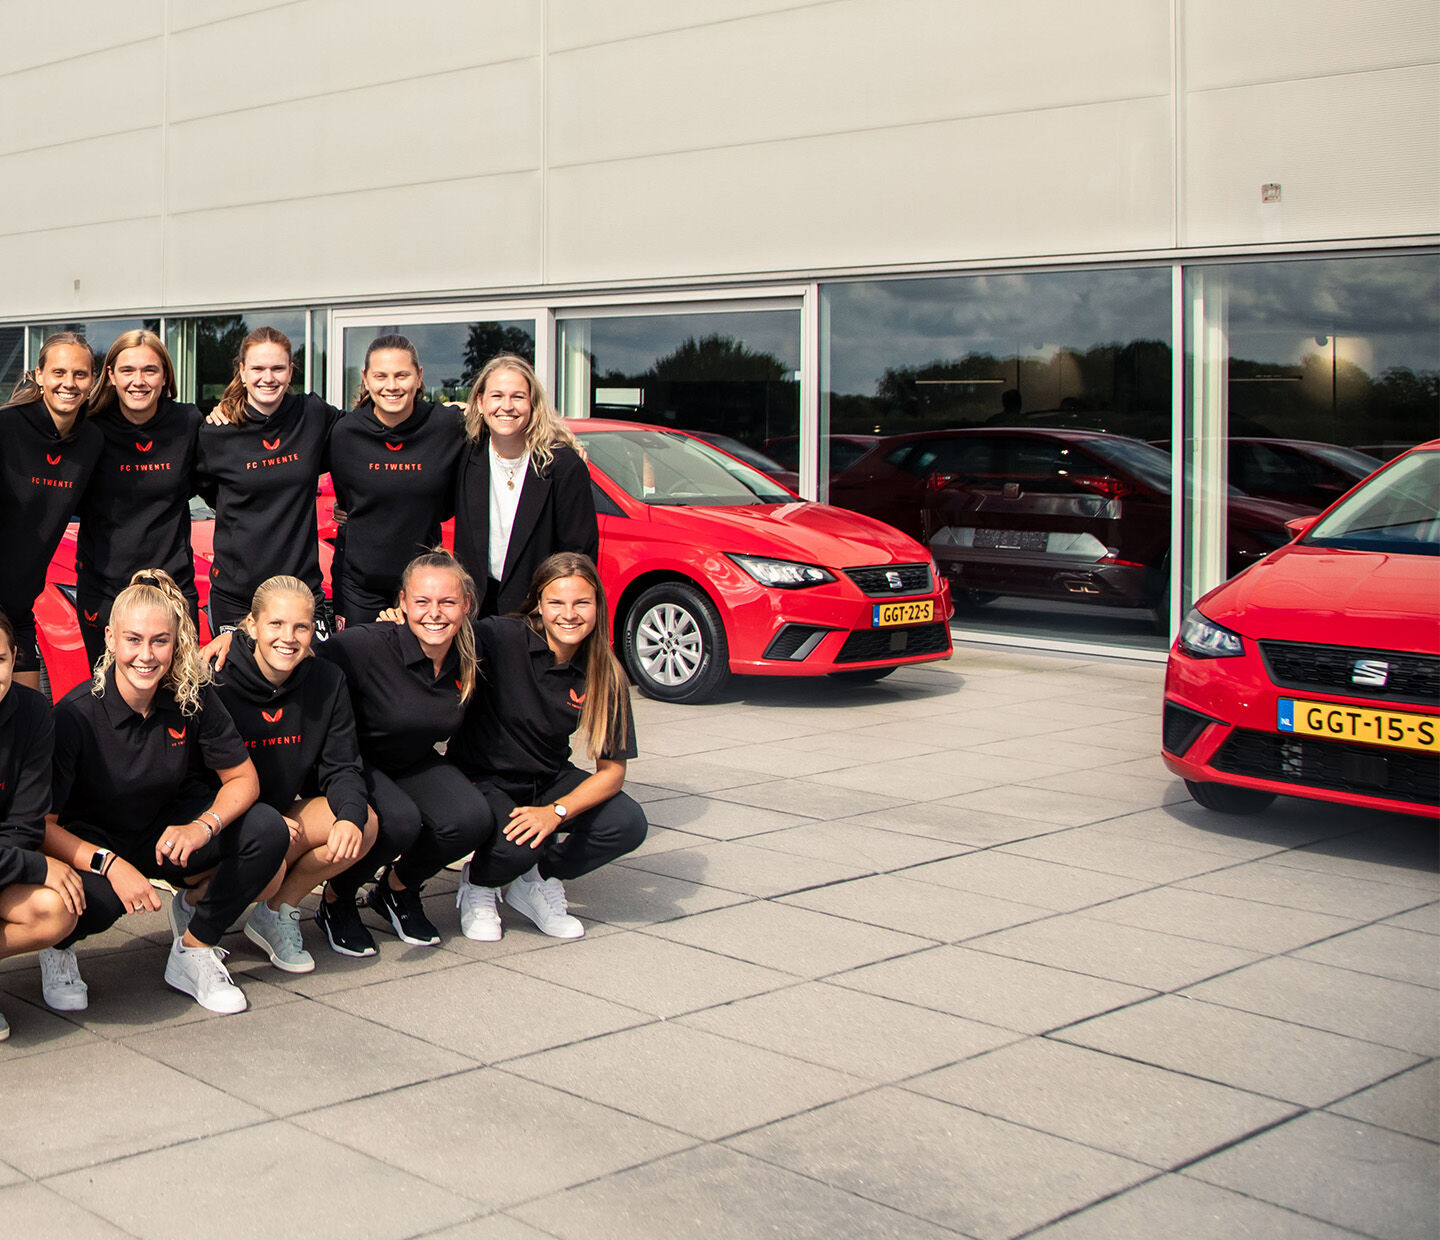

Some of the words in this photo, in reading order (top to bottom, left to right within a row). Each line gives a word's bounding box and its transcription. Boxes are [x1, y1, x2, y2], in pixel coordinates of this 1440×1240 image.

[120, 464, 131, 472] FC
[135, 462, 171, 471] TWENTE
[246, 461, 258, 470] FC
[262, 453, 299, 467] TWENTE
[369, 463, 380, 471] FC
[384, 463, 422, 471] TWENTE
[32, 476, 40, 485] FC
[43, 478, 73, 489] TWENTE
[883, 603, 930, 623] GGT-22-S
[1280, 717, 1292, 727] NL
[1307, 707, 1435, 746] GGT-15-S
[244, 740, 257, 749] FC
